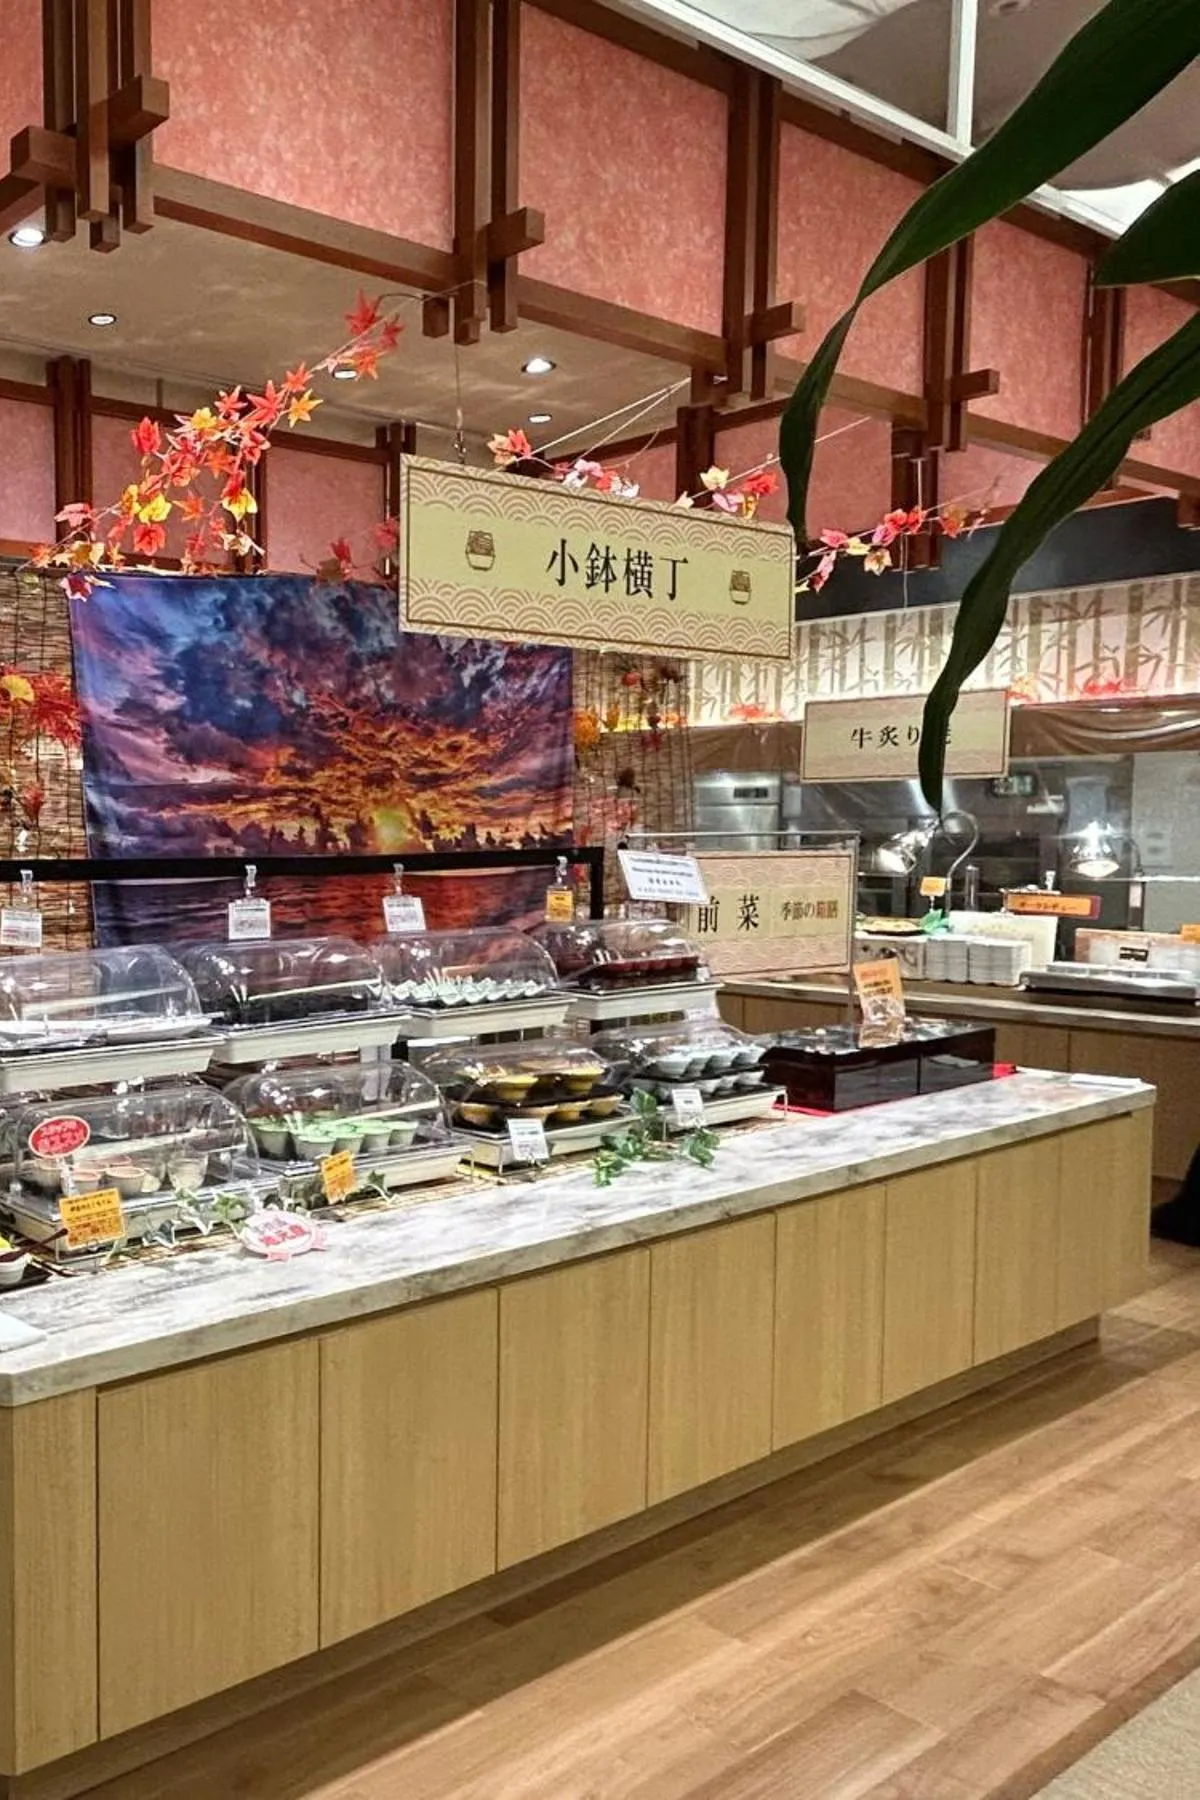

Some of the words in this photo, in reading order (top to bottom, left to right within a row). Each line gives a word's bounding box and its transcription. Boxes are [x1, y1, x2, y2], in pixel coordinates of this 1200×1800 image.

[545, 538, 689, 601] 小鉢横丁
[850, 725, 952, 749] 牛炙り
[697, 894, 760, 933] 前菜
